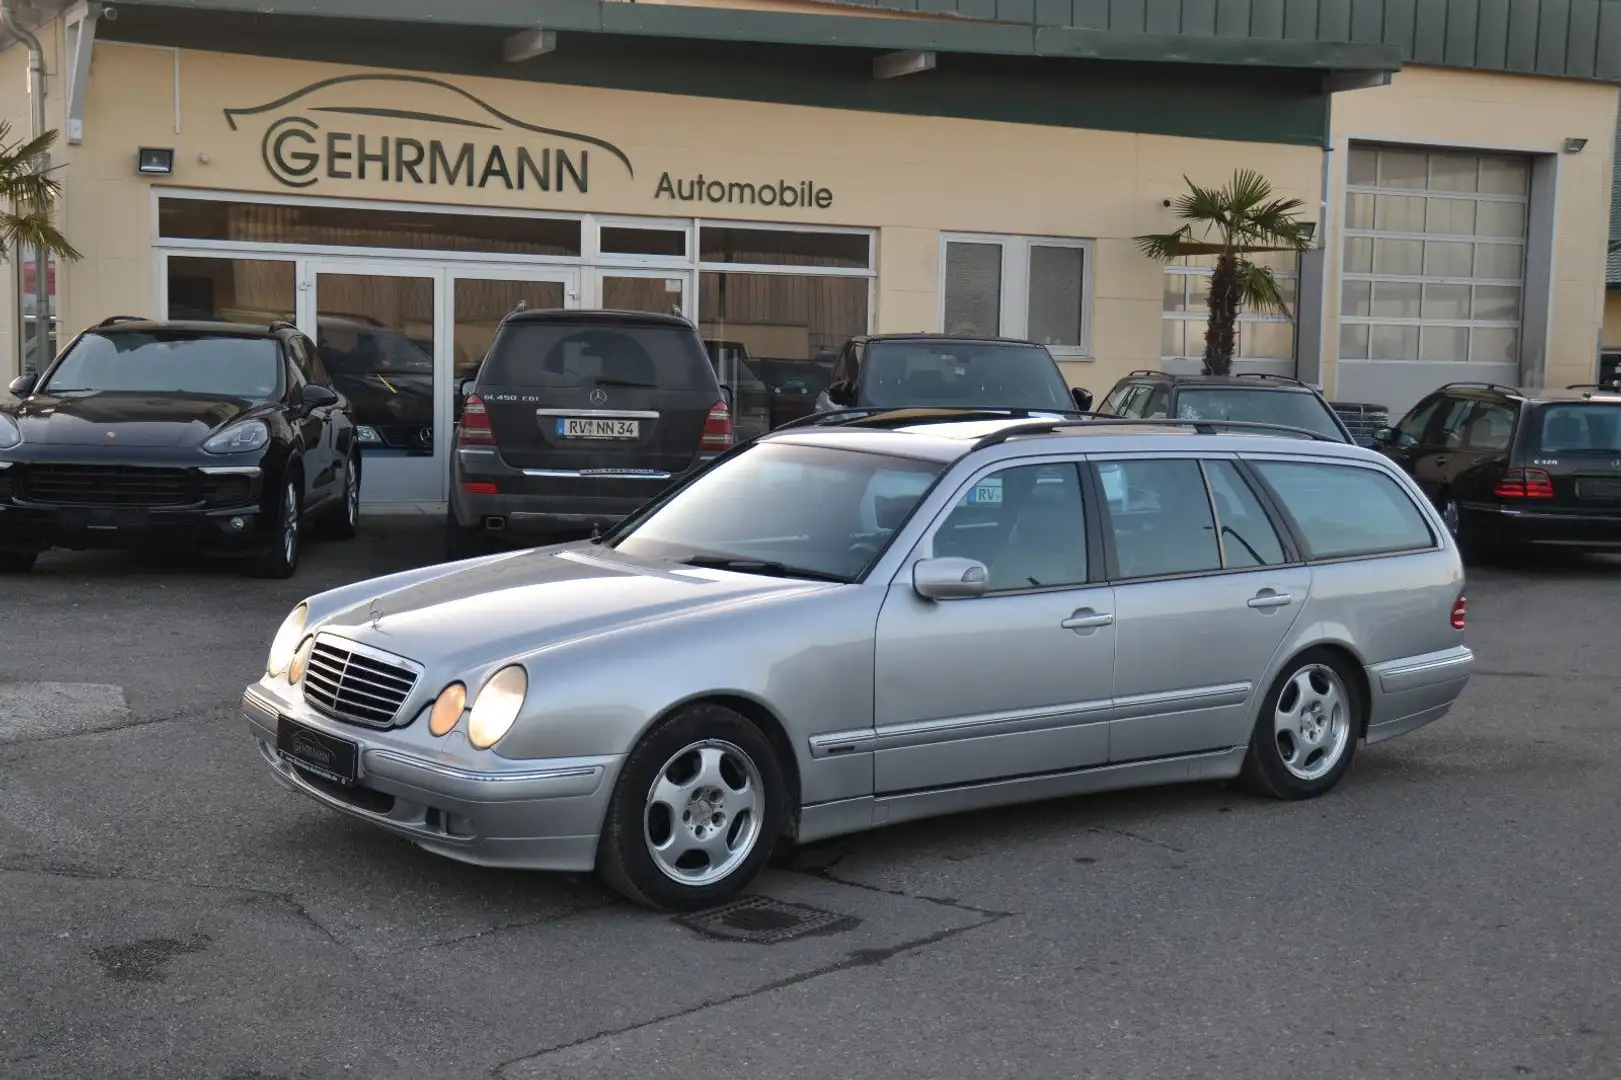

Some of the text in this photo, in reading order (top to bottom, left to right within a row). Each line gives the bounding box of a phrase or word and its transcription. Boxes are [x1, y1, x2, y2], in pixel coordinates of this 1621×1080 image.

[262, 116, 588, 194] GEHRMANN
[654, 171, 833, 208] Automobile
[569, 421, 634, 435] RV NN 34
